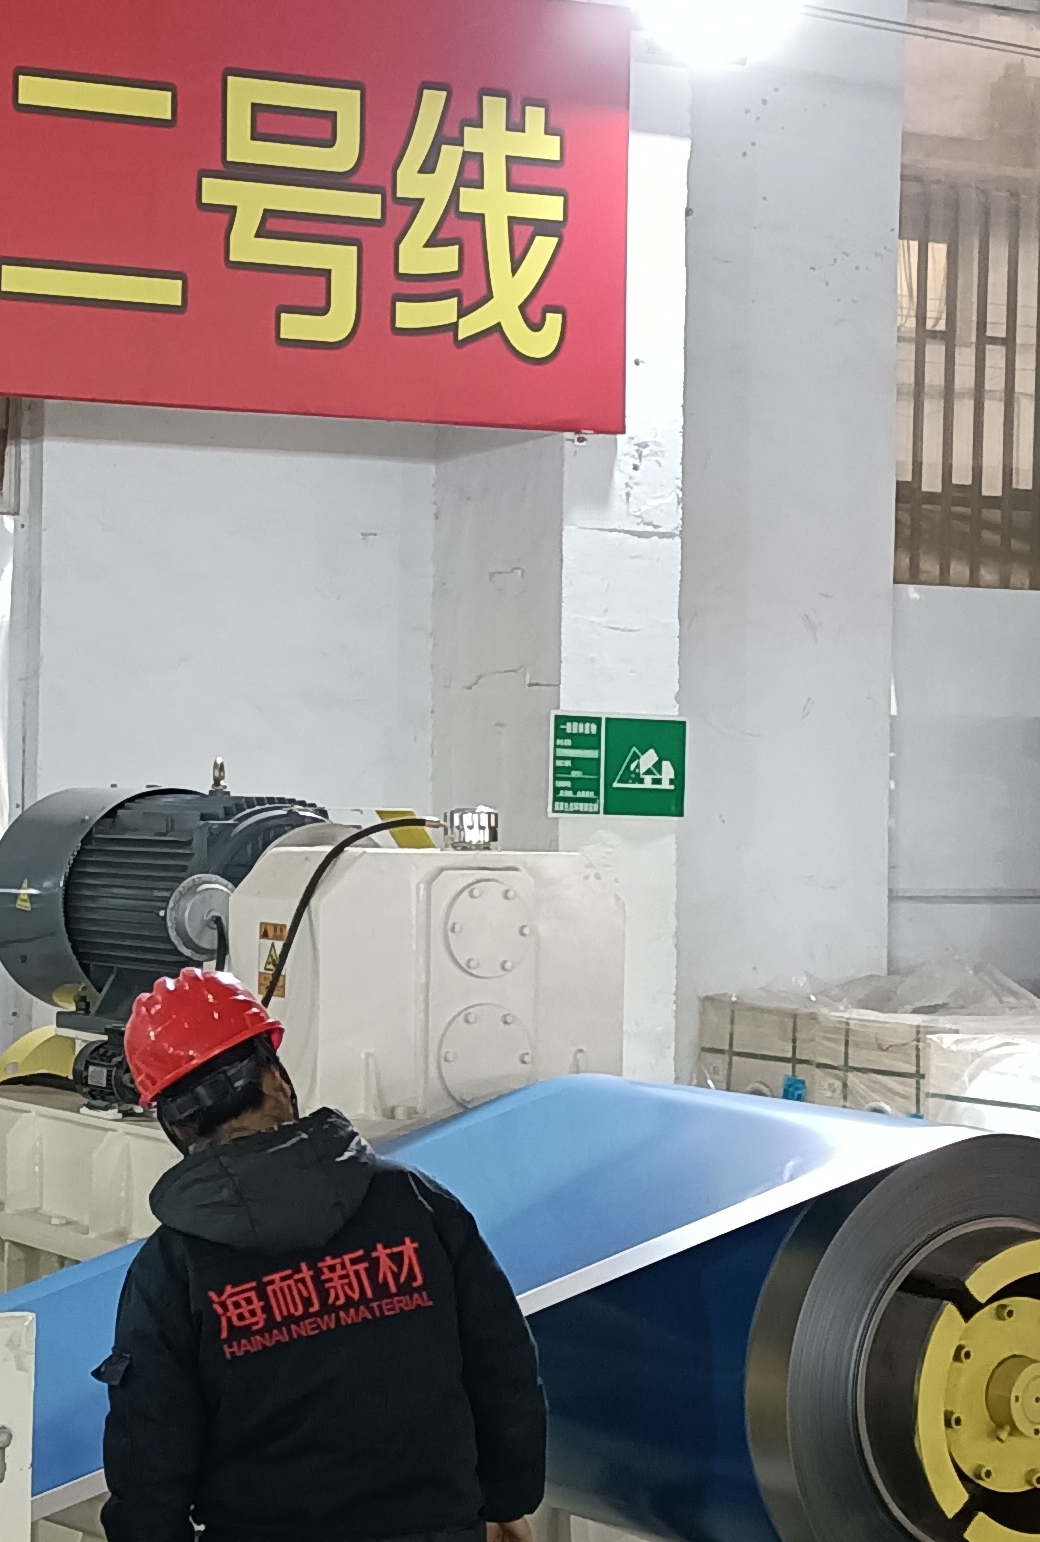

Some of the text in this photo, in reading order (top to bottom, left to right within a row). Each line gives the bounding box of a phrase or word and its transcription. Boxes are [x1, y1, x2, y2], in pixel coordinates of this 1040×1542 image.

[208, 1236, 424, 1339] 海耐新材
[223, 1291, 434, 1360] HAINAI NEW MATERIAL
